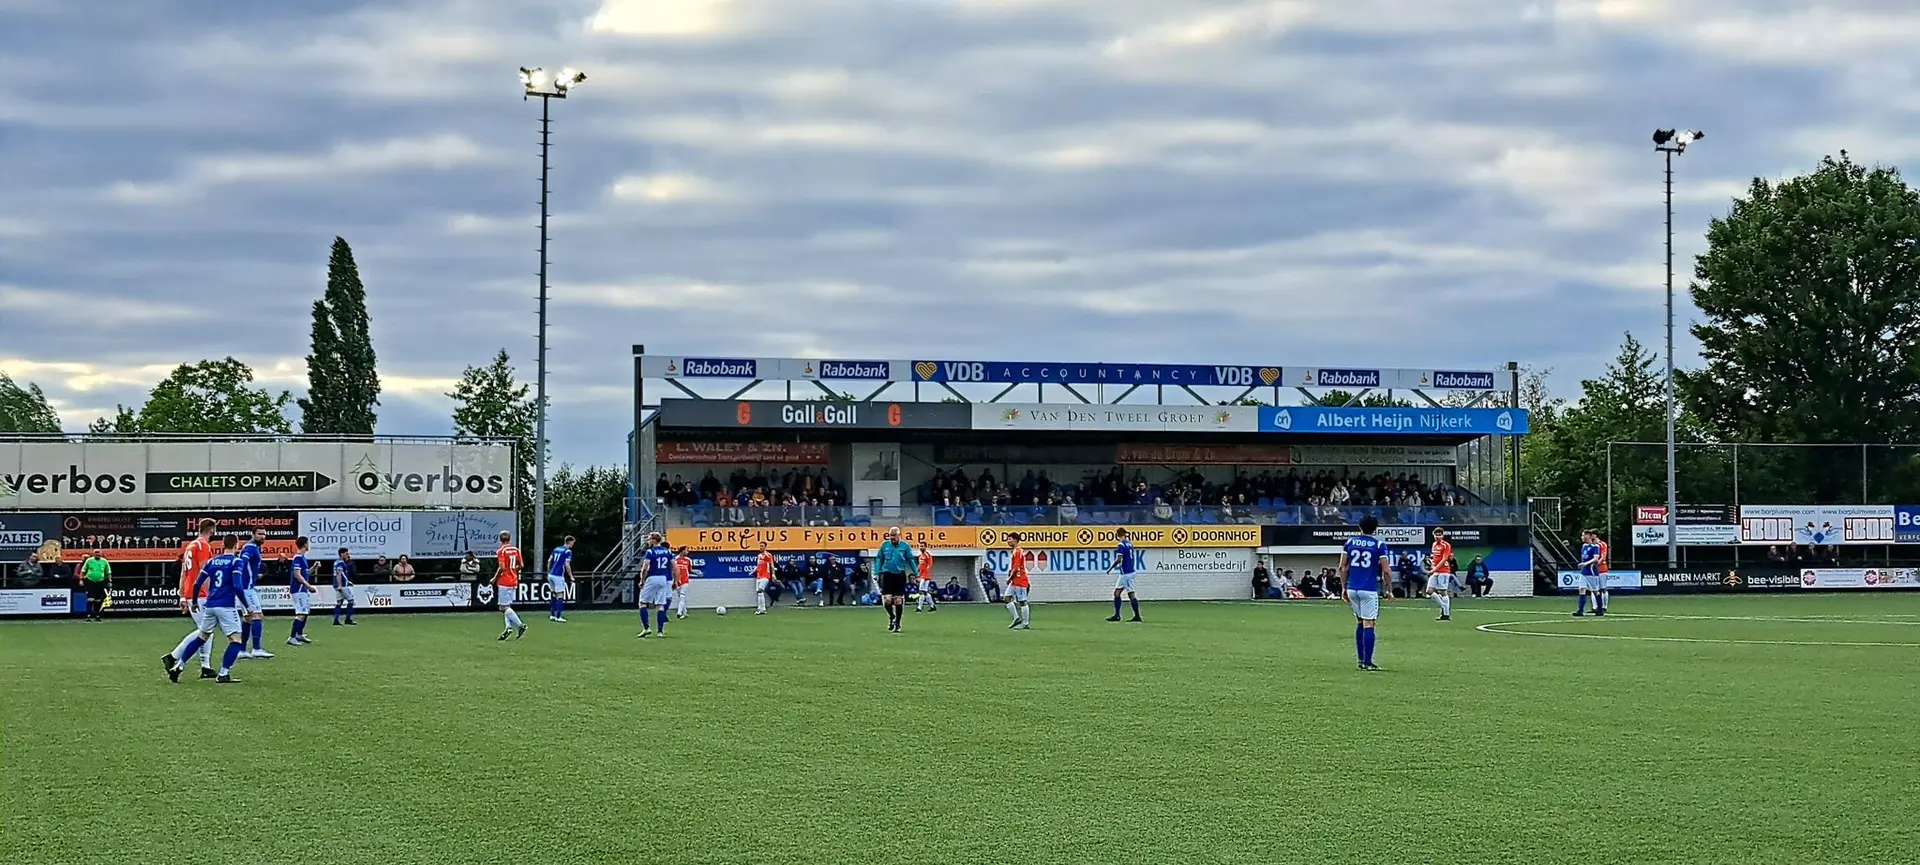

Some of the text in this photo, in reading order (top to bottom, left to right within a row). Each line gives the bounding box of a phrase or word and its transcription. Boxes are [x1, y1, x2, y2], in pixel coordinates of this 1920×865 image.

[686, 361, 753, 375] Rabobank
[822, 362, 887, 377] Rabobank
[944, 362, 1254, 385] VDB ACCOUNTANCY VDB
[1320, 369, 1377, 384] Rabobank
[1435, 373, 1492, 387] Rabobank
[1317, 413, 1472, 431] Albert Heijn Nijkerk
[170, 475, 307, 488] CHALETS OP MAAT
[239, 517, 294, 526] Middelaar
[309, 517, 401, 532] silvercloud
[0, 533, 40, 544] ALEIS
[309, 533, 386, 545] computing
[804, 529, 947, 545] Fysiotheapie
[1001, 531, 1069, 542] DORNHOF
[1192, 531, 1257, 541] DOORNHOF
[1178, 550, 1227, 559] Bouw- en
[1350, 549, 1372, 568] 23
[655, 556, 669, 569] 12
[1156, 561, 1247, 572] Aannemersbedrijf
[214, 569, 223, 588] 3
[1658, 572, 1721, 582] BANKEN MARKT
[1747, 575, 1800, 585] bee-visible
[129, 587, 148, 597] der
